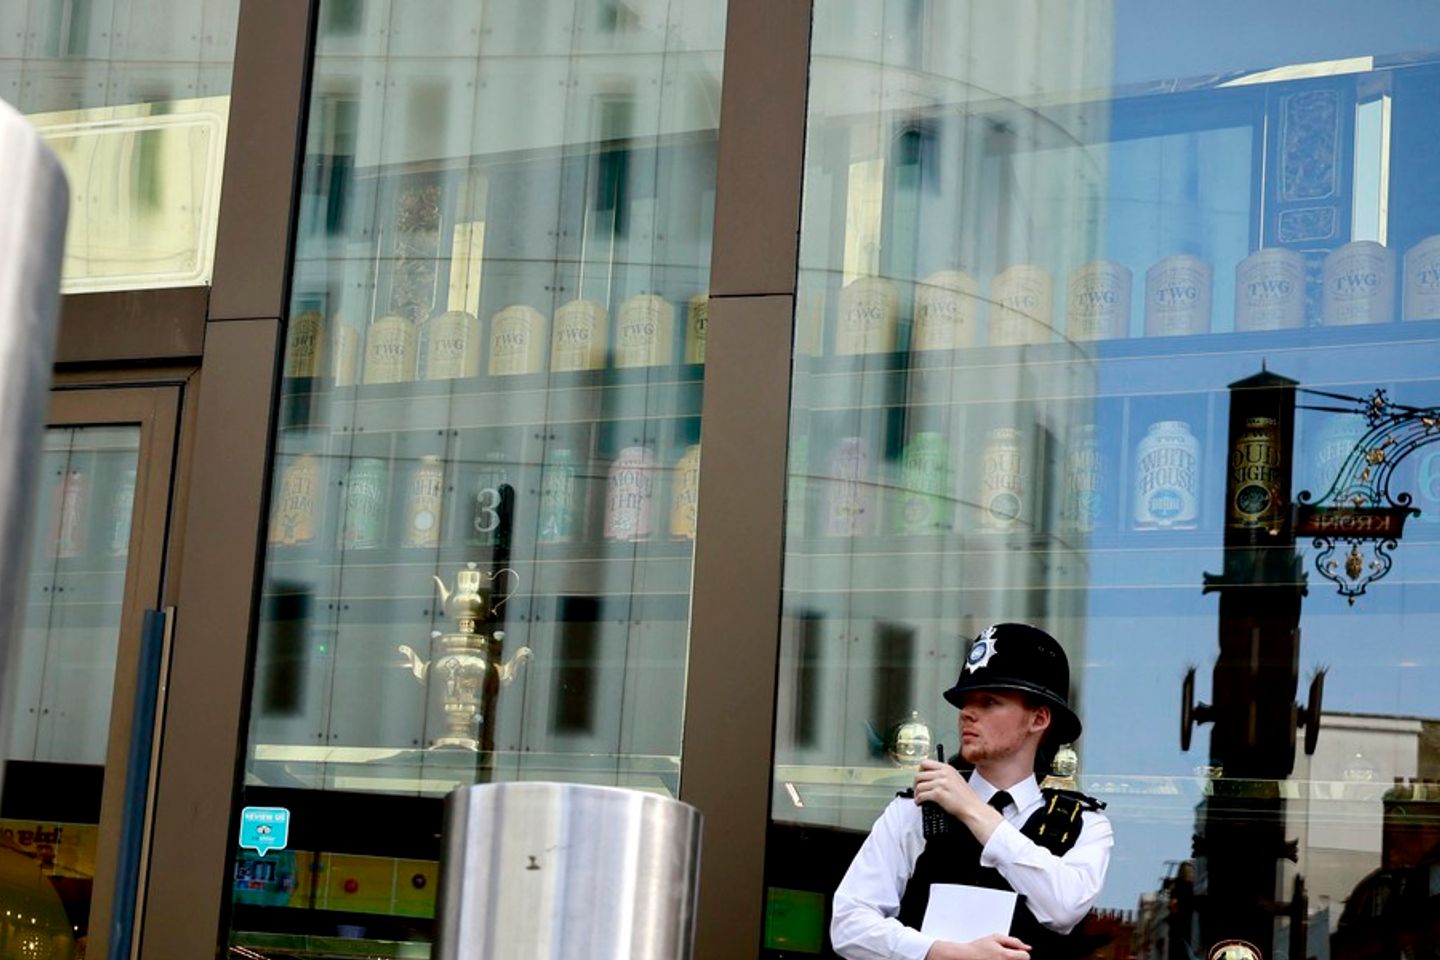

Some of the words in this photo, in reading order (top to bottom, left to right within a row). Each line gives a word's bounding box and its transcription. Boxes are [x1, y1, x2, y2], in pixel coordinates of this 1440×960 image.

[1247, 280, 1291, 297] TWG
[1335, 273, 1378, 291] TWG
[1075, 290, 1115, 307] TWG
[1156, 286, 1198, 301] TWG
[557, 327, 590, 342] TWG
[622, 323, 655, 337] TWG
[435, 339, 464, 352] TWG
[494, 333, 525, 346] TWG
[373, 342, 406, 355] TWG
[1140, 447, 1198, 474] WHITE
[1231, 443, 1279, 467] OUD
[1138, 466, 1198, 496] HOUSE
[474, 487, 500, 533] 3
